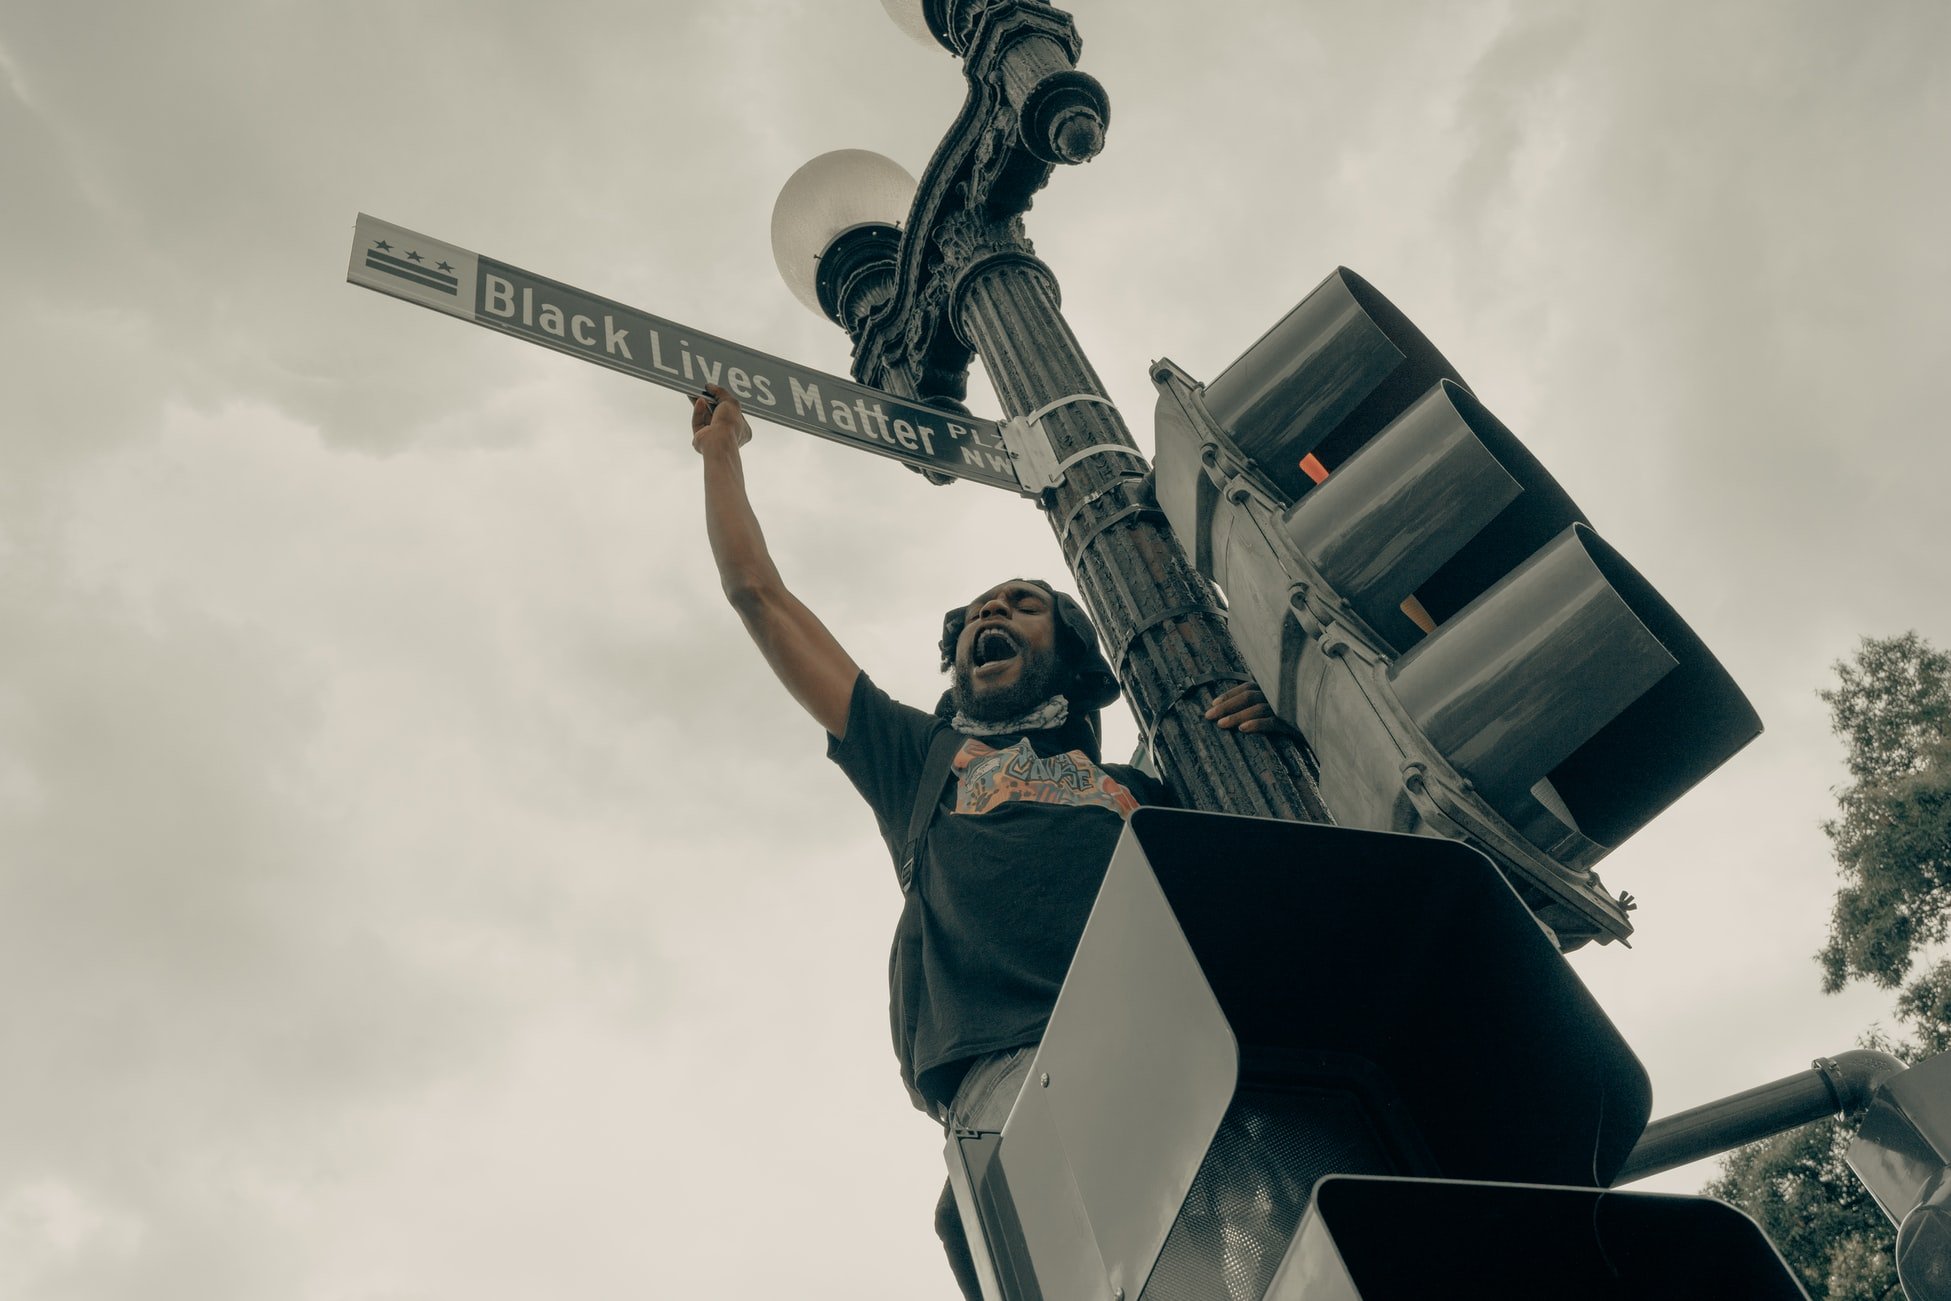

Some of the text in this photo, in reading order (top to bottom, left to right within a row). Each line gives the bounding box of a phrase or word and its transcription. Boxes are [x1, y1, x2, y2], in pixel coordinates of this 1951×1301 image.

[484, 273, 935, 456] Black Lives Matter
[960, 446, 1014, 475] NW
